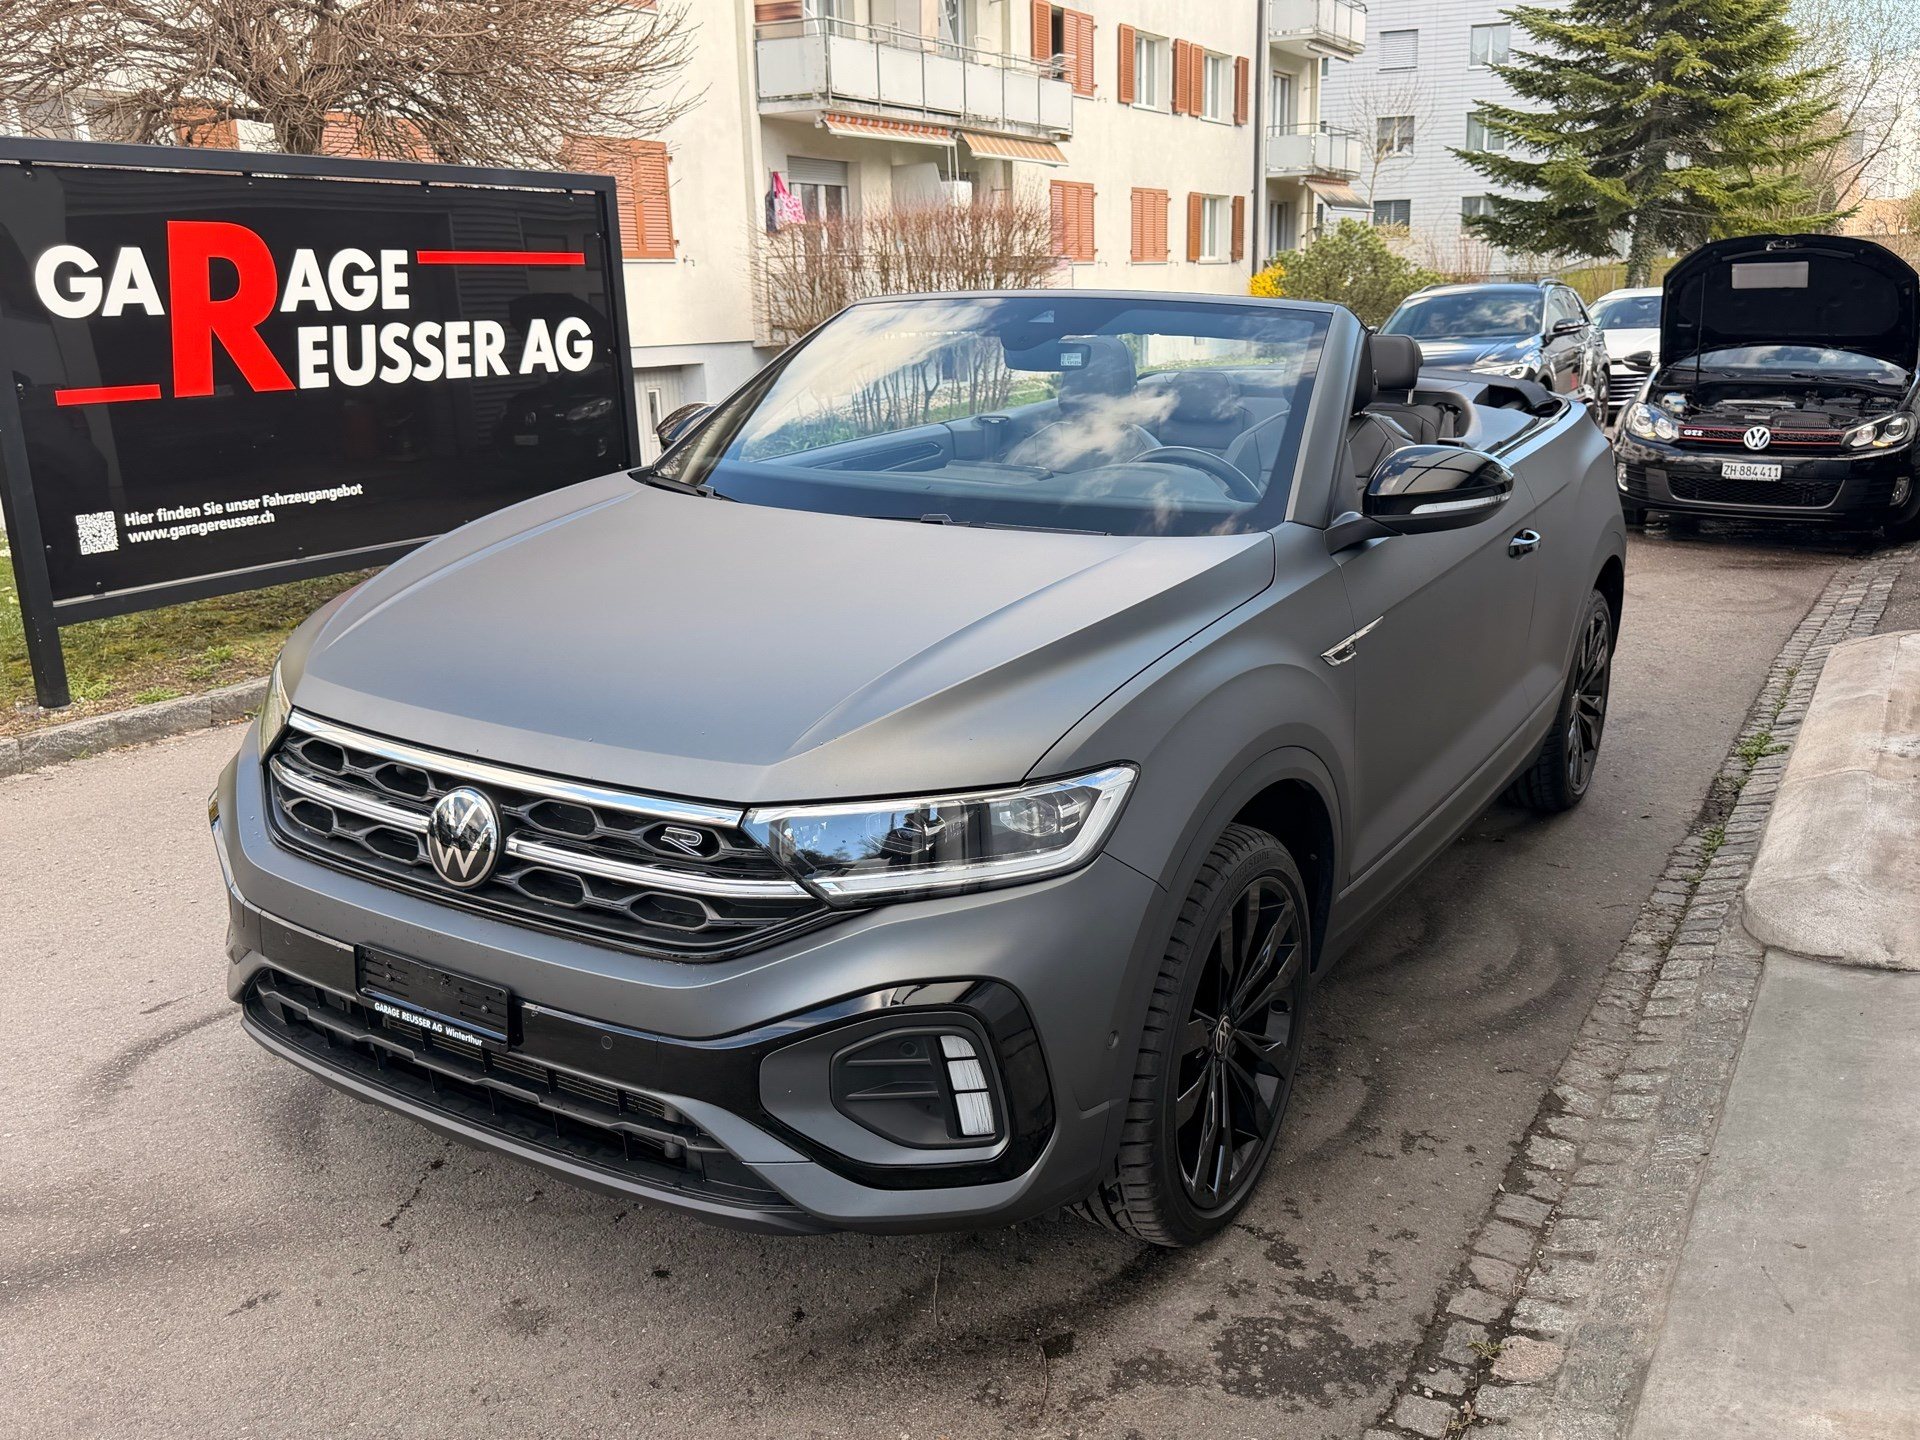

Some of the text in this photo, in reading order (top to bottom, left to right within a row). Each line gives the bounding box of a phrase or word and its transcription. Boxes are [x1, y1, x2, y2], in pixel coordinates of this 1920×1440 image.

[35, 221, 410, 398] GARAGE
[518, 316, 594, 374] AG
[125, 483, 363, 527] Hier finden Sie unser Fahrzeugangebot
[128, 510, 276, 544] www.garagereusser.ch
[374, 1002, 483, 1047] GARAGE REUSSER AG Winterthur
